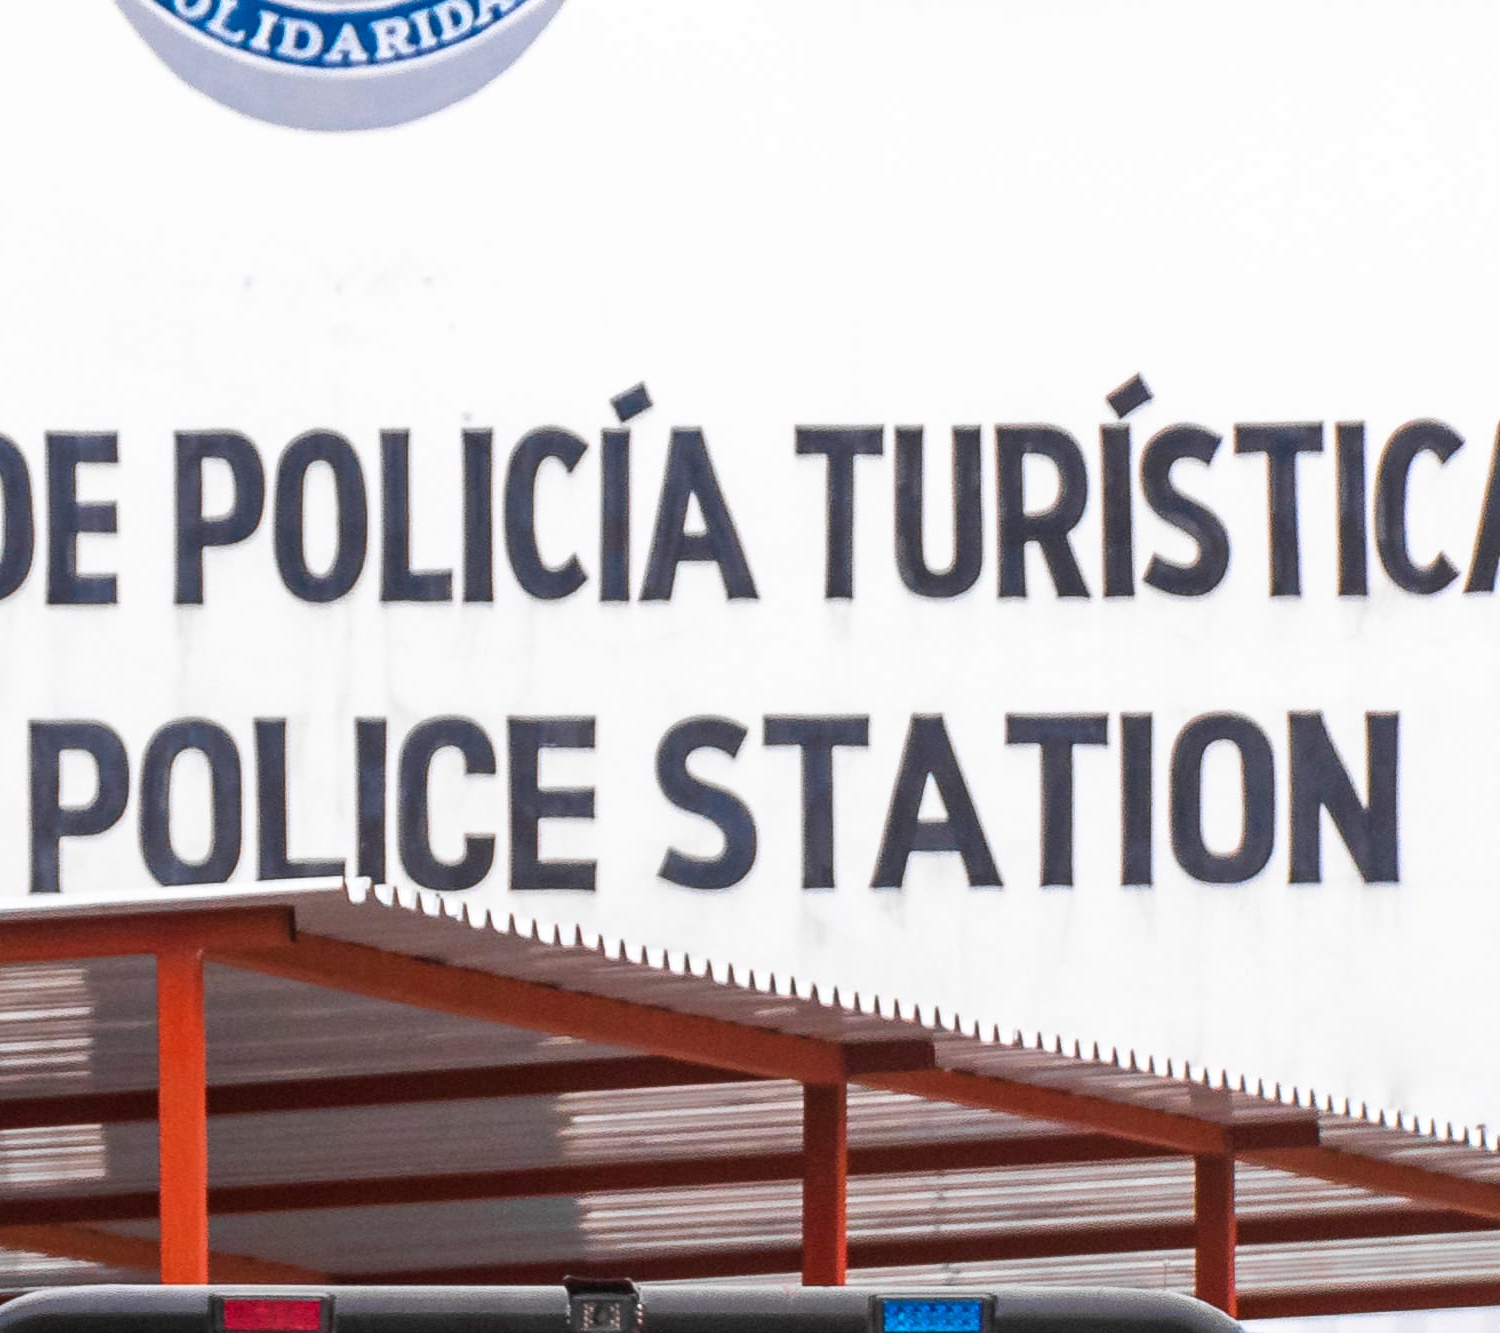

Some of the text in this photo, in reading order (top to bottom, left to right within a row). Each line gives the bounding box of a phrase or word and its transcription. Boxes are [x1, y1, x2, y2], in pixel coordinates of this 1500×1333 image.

[176, 384, 758, 604] POLICÍA
[30, 716, 596, 893] POLICE
[658, 712, 1400, 890] STATION
